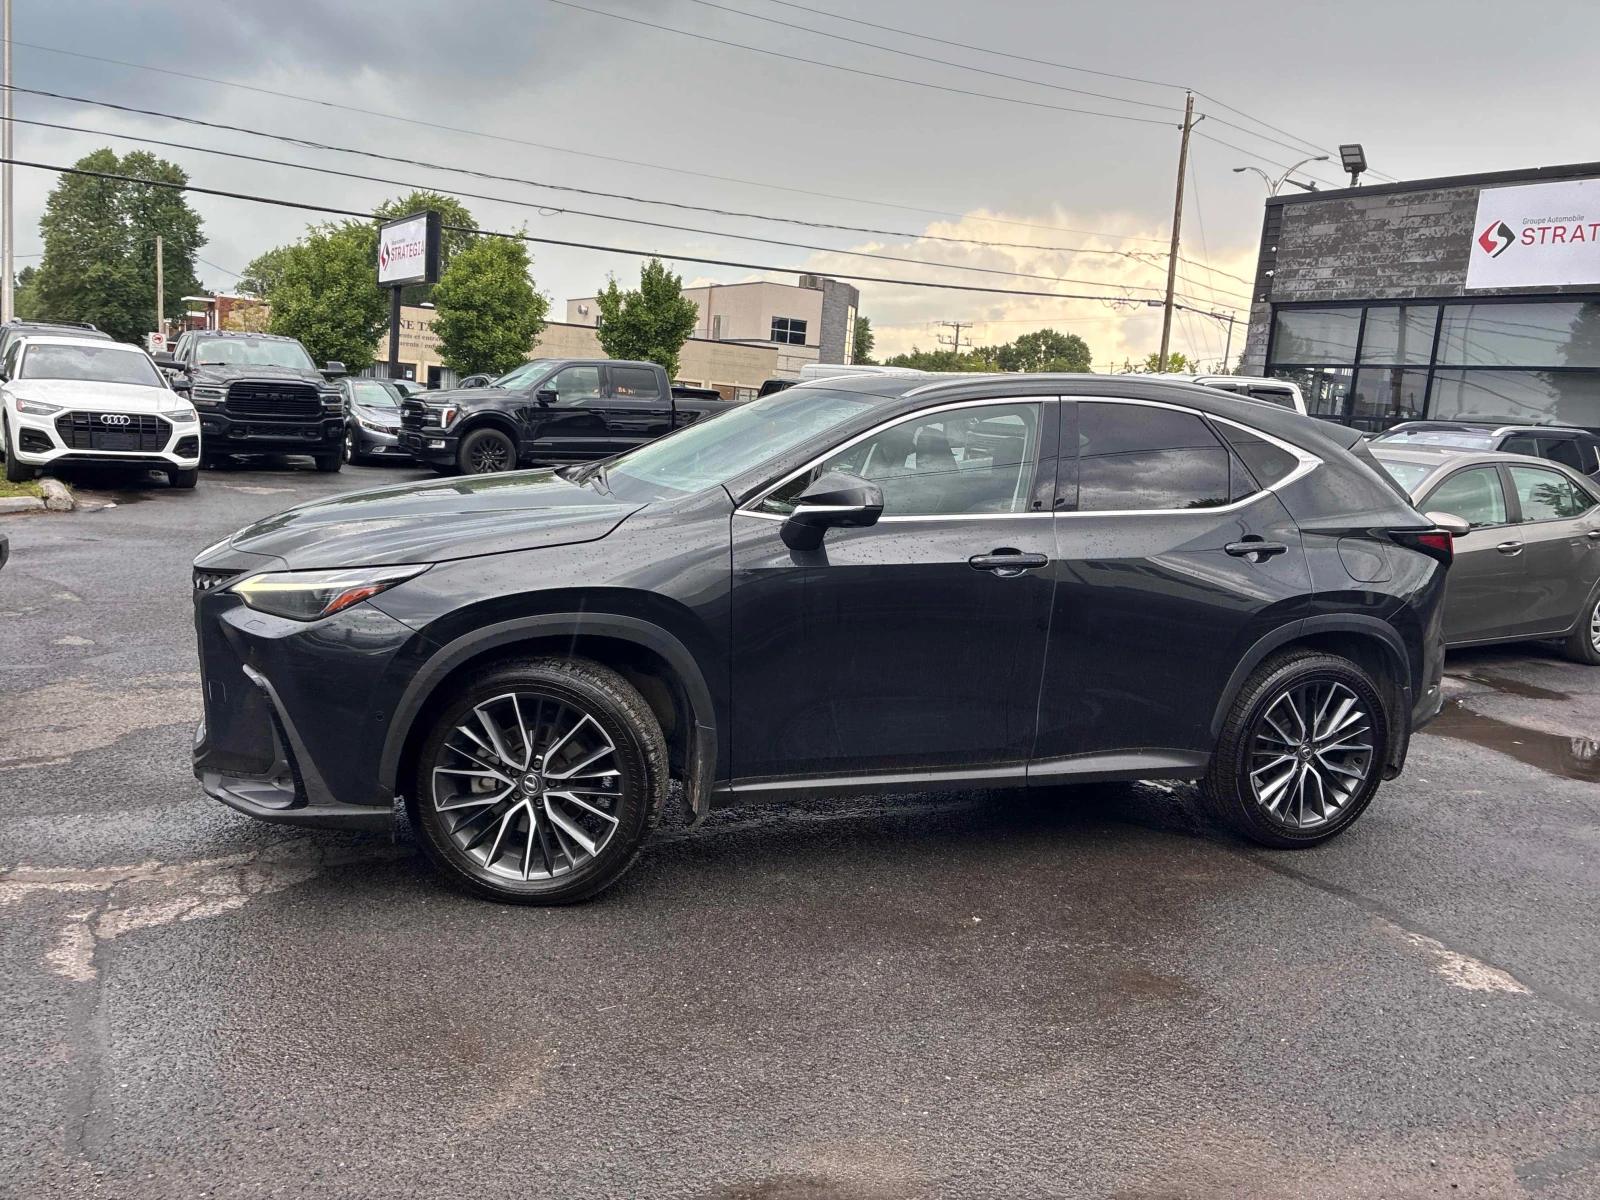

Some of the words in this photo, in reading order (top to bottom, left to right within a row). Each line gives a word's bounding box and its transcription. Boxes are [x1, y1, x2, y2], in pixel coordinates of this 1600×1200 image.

[1522, 217, 1546, 225] Groupe
[1547, 215, 1585, 223] Automobile
[1520, 223, 1600, 246] STRAT
[391, 240, 424, 261] STRATEGIA
